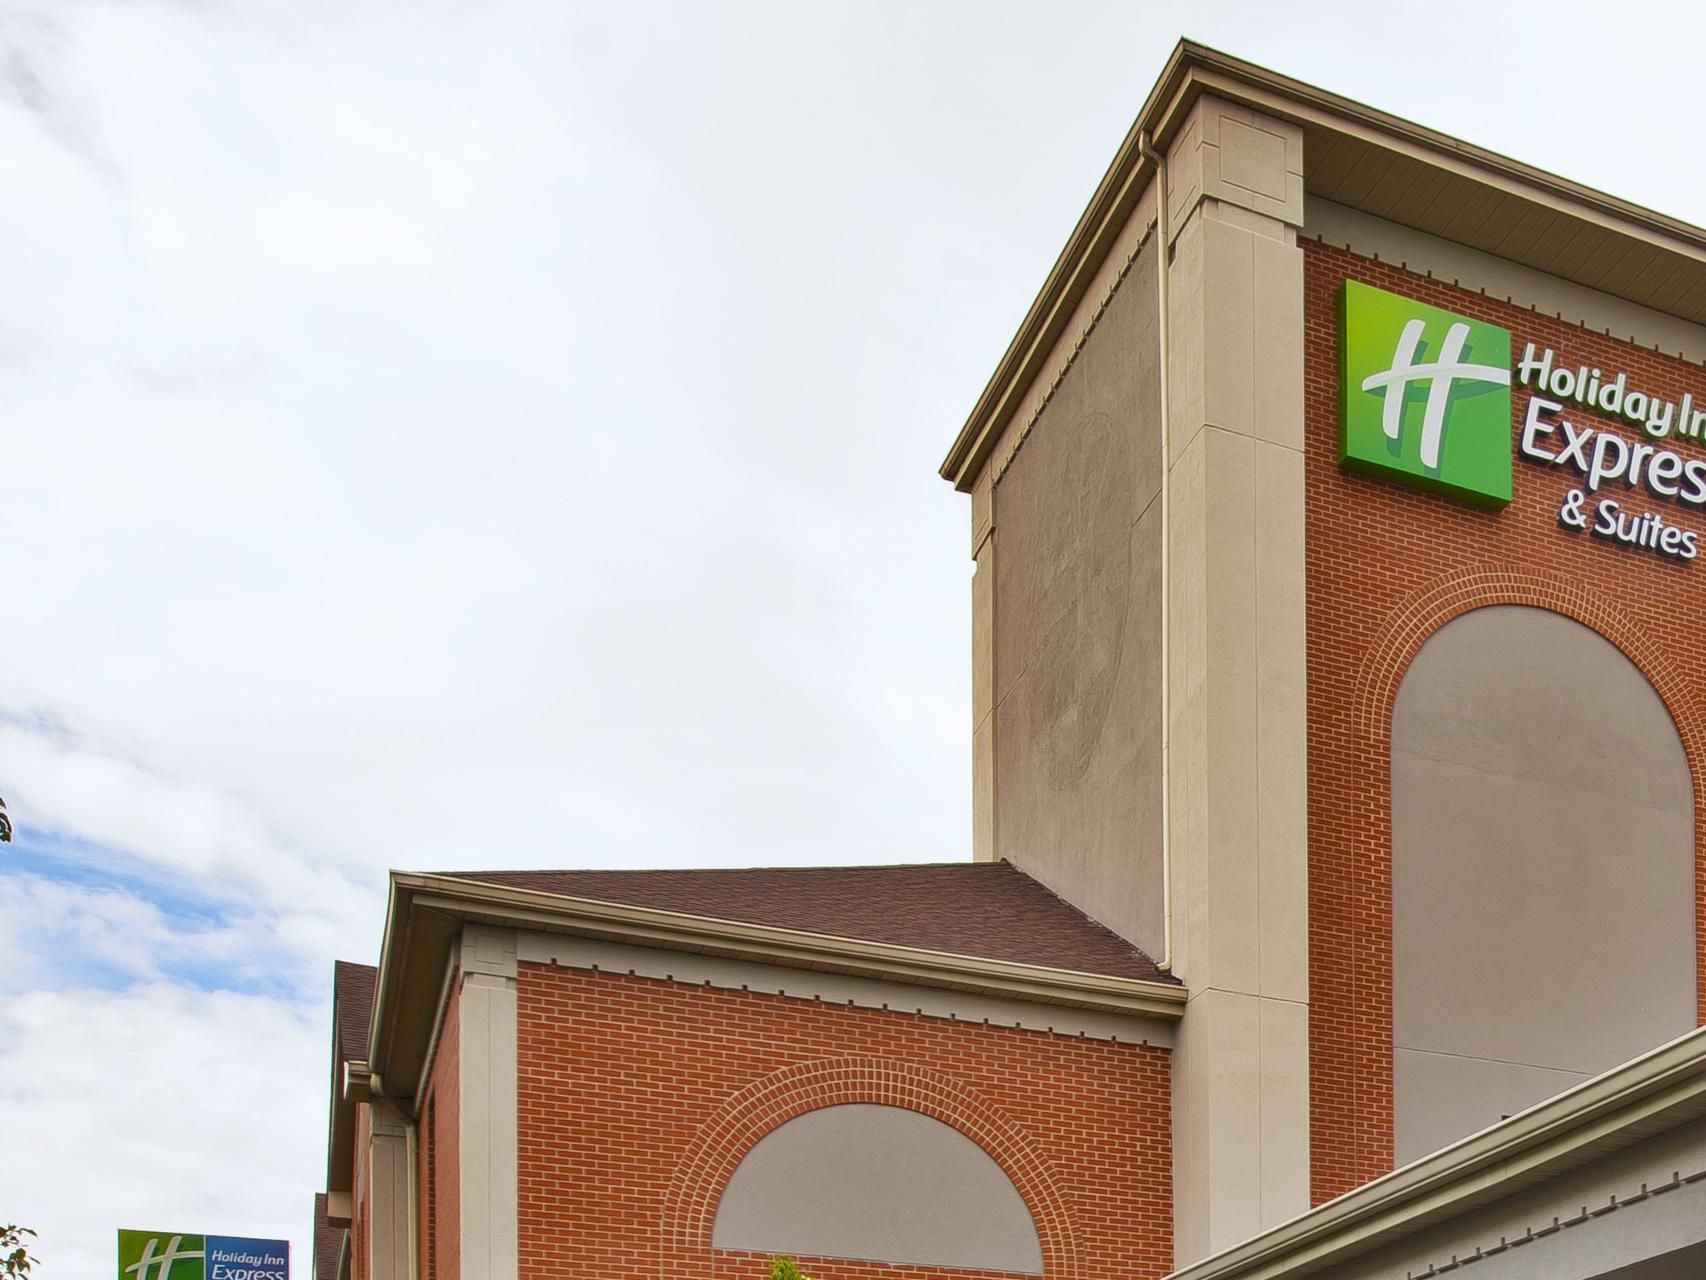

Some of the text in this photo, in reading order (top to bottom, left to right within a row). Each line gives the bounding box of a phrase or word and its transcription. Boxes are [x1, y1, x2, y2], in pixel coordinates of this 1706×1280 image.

[1518, 342, 1674, 438] Holiday
[1560, 488, 1698, 559] & Suites
[211, 1250, 285, 1267] Holiday Inn
